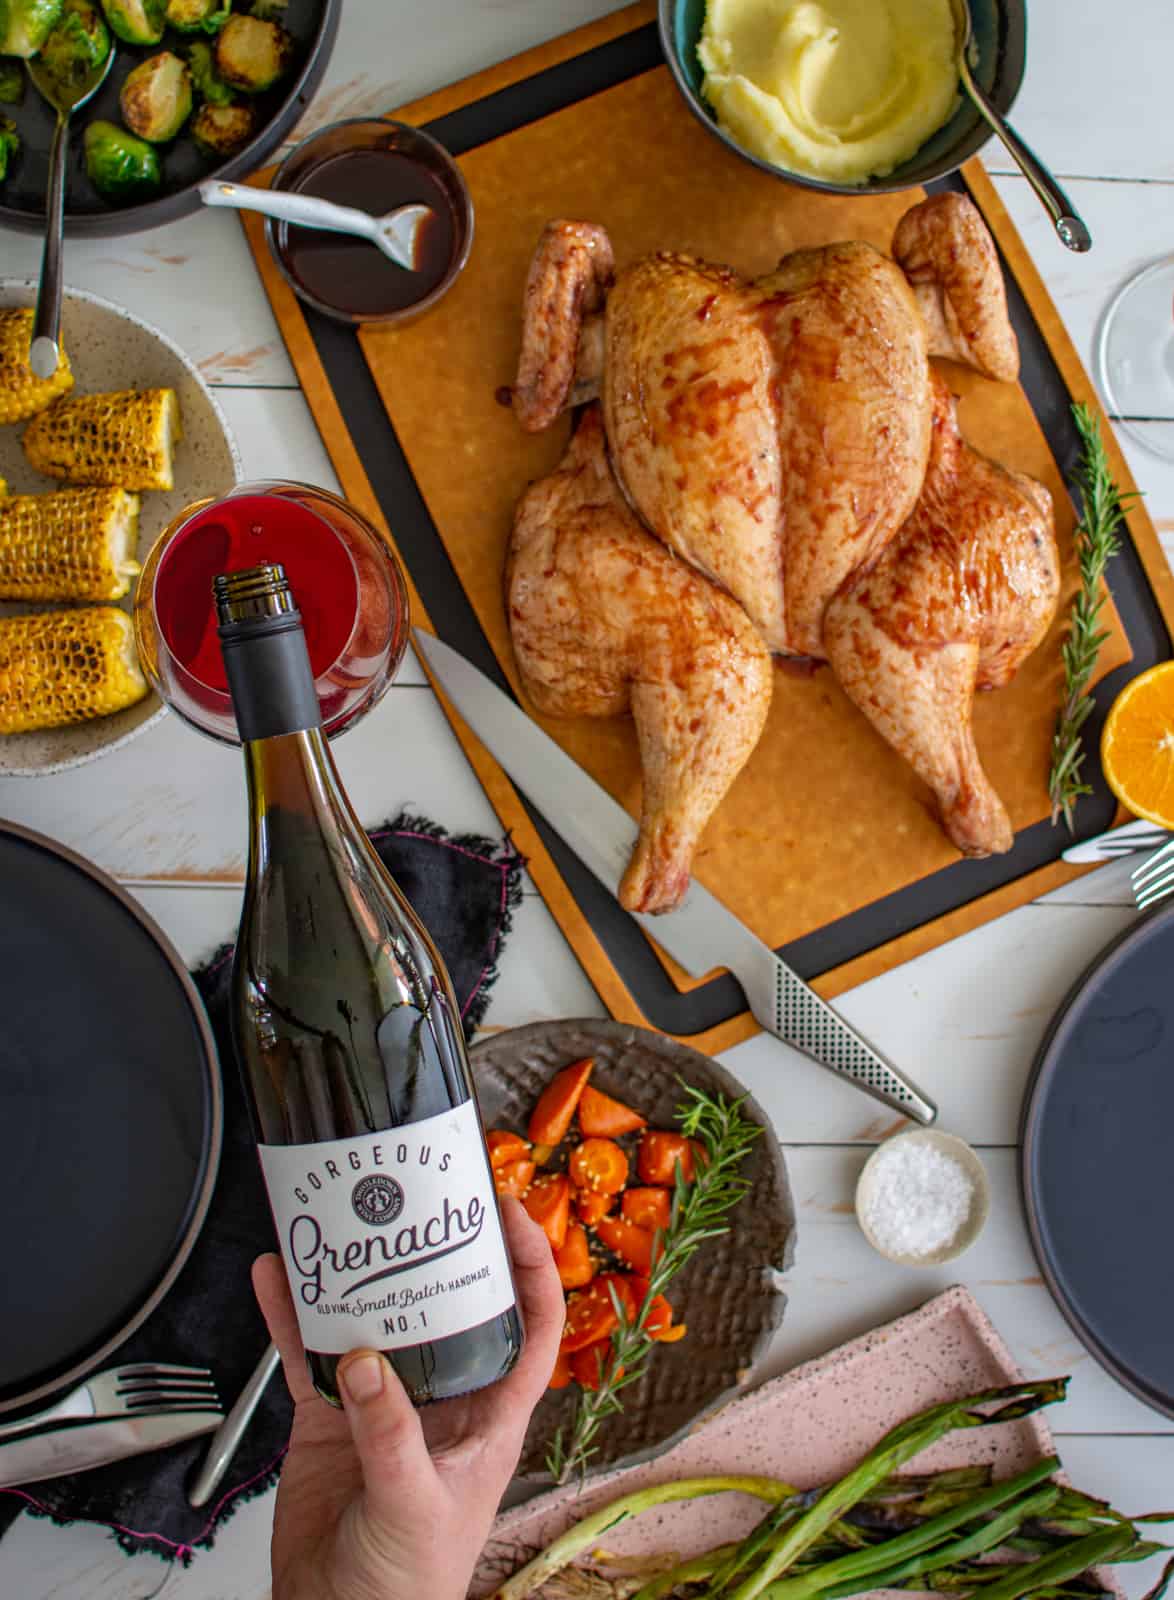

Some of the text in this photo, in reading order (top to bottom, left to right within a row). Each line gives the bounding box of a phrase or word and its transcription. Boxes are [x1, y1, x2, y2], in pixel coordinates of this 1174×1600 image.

[294, 1144, 451, 1204] GORGEOUS
[289, 1197, 486, 1305] Grenache
[448, 1265, 491, 1291] HANDMADE
[317, 1303, 350, 1314] OLD VINE
[351, 1280, 447, 1317] Small Batch
